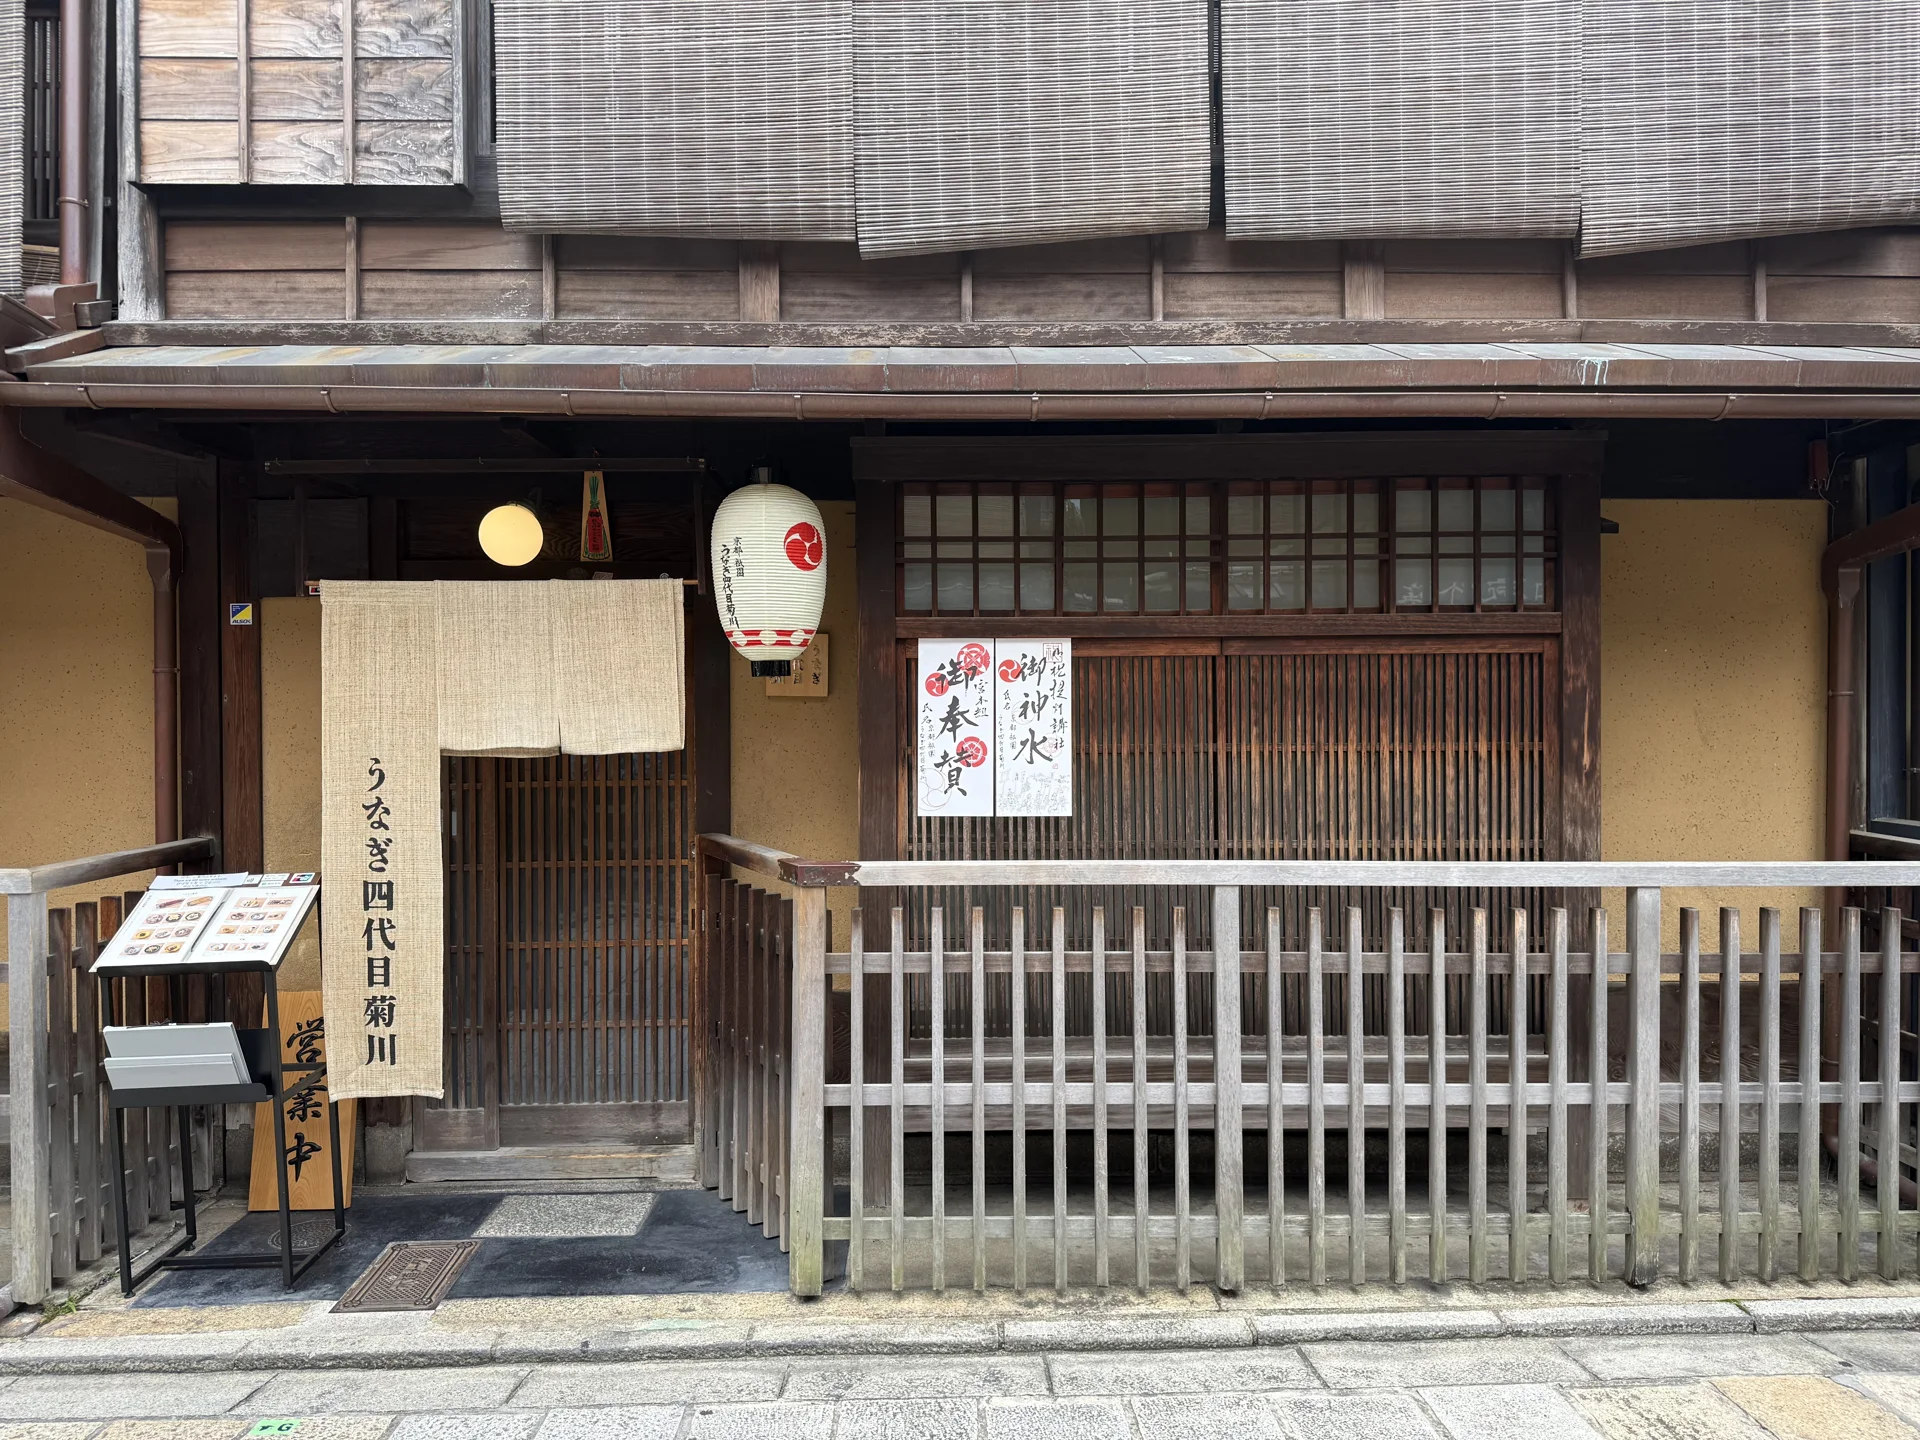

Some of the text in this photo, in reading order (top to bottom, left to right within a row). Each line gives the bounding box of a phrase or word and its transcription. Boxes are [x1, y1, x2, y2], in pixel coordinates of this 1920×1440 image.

[720, 543, 740, 629] うなぎ四代目菊川
[1013, 653, 1053, 765] 御神水
[361, 757, 397, 1067] うなぎ四代目菊川
[285, 1016, 328, 1182] 営業中
